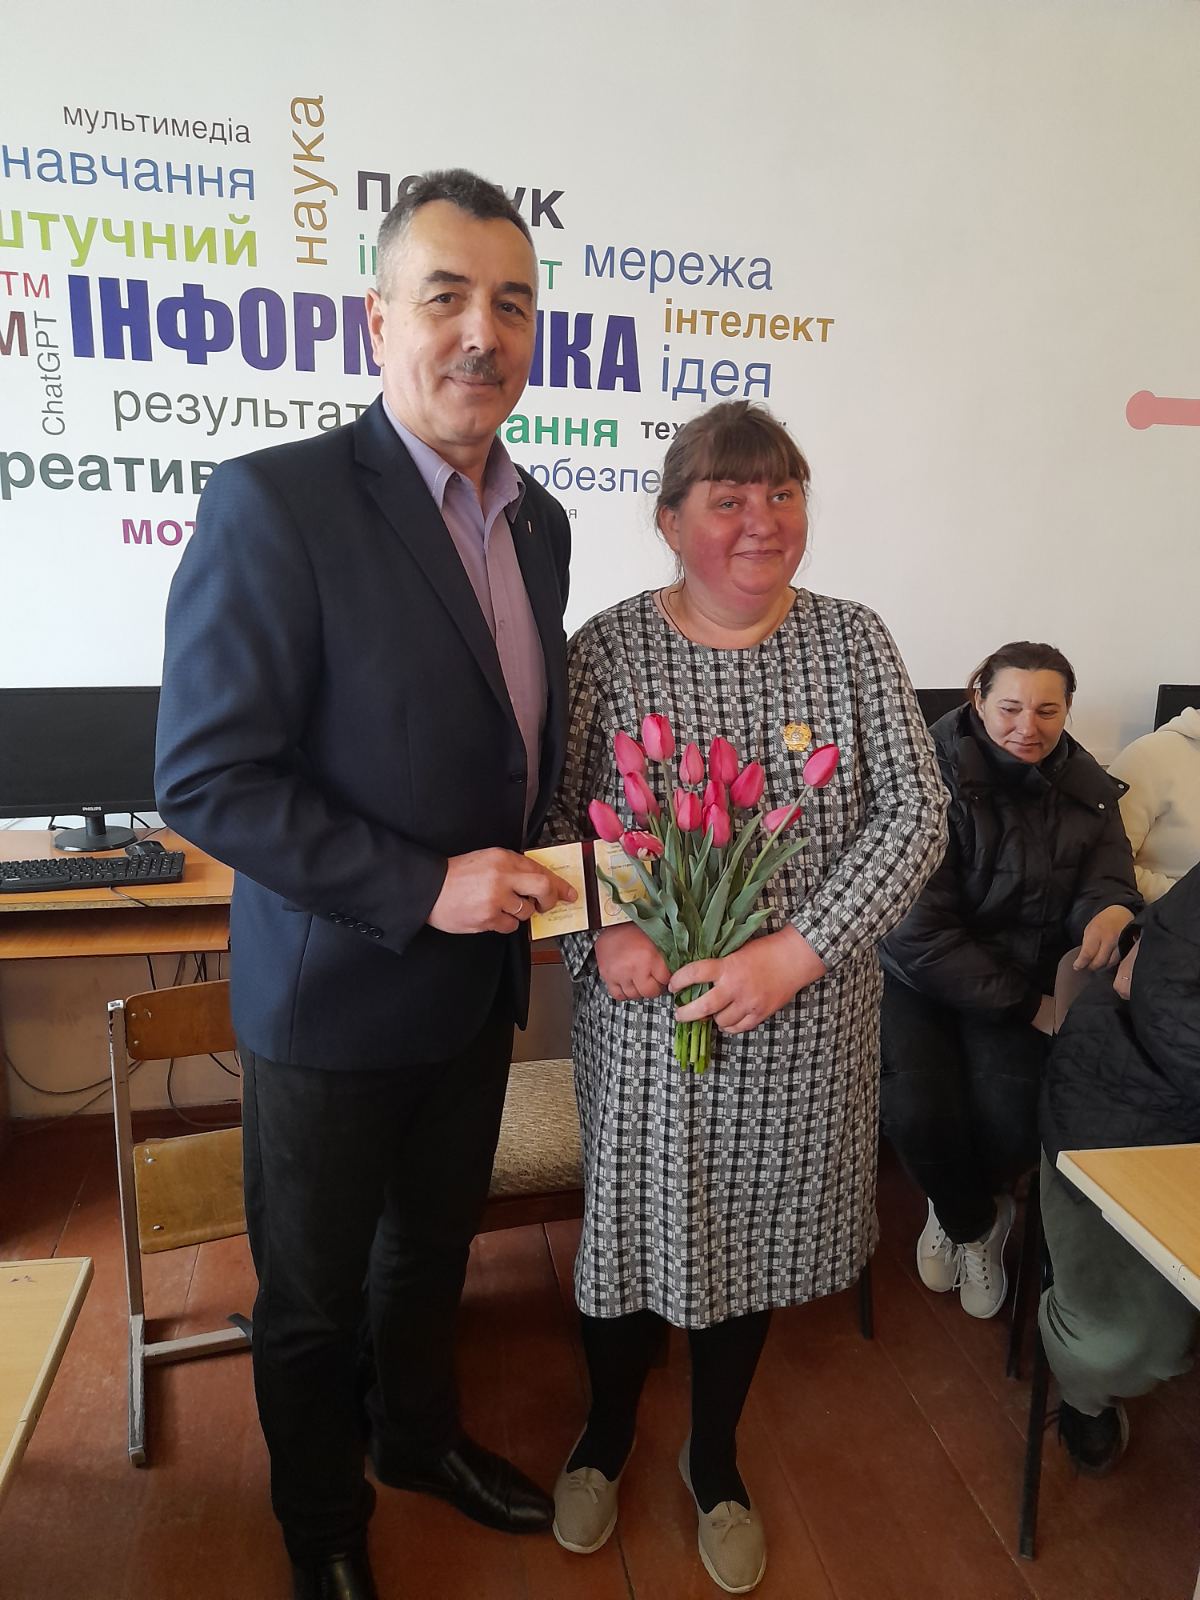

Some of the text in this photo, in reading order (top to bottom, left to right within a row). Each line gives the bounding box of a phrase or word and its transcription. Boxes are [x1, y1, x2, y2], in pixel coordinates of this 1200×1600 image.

[63, 106, 252, 145] мультимедіа
[1, 144, 255, 200] навчання
[290, 95, 338, 265] наука
[584, 244, 773, 294] мережа
[664, 297, 835, 343] інтелект
[34, 310, 66, 436] ChatGPT
[661, 344, 772, 402] ідея
